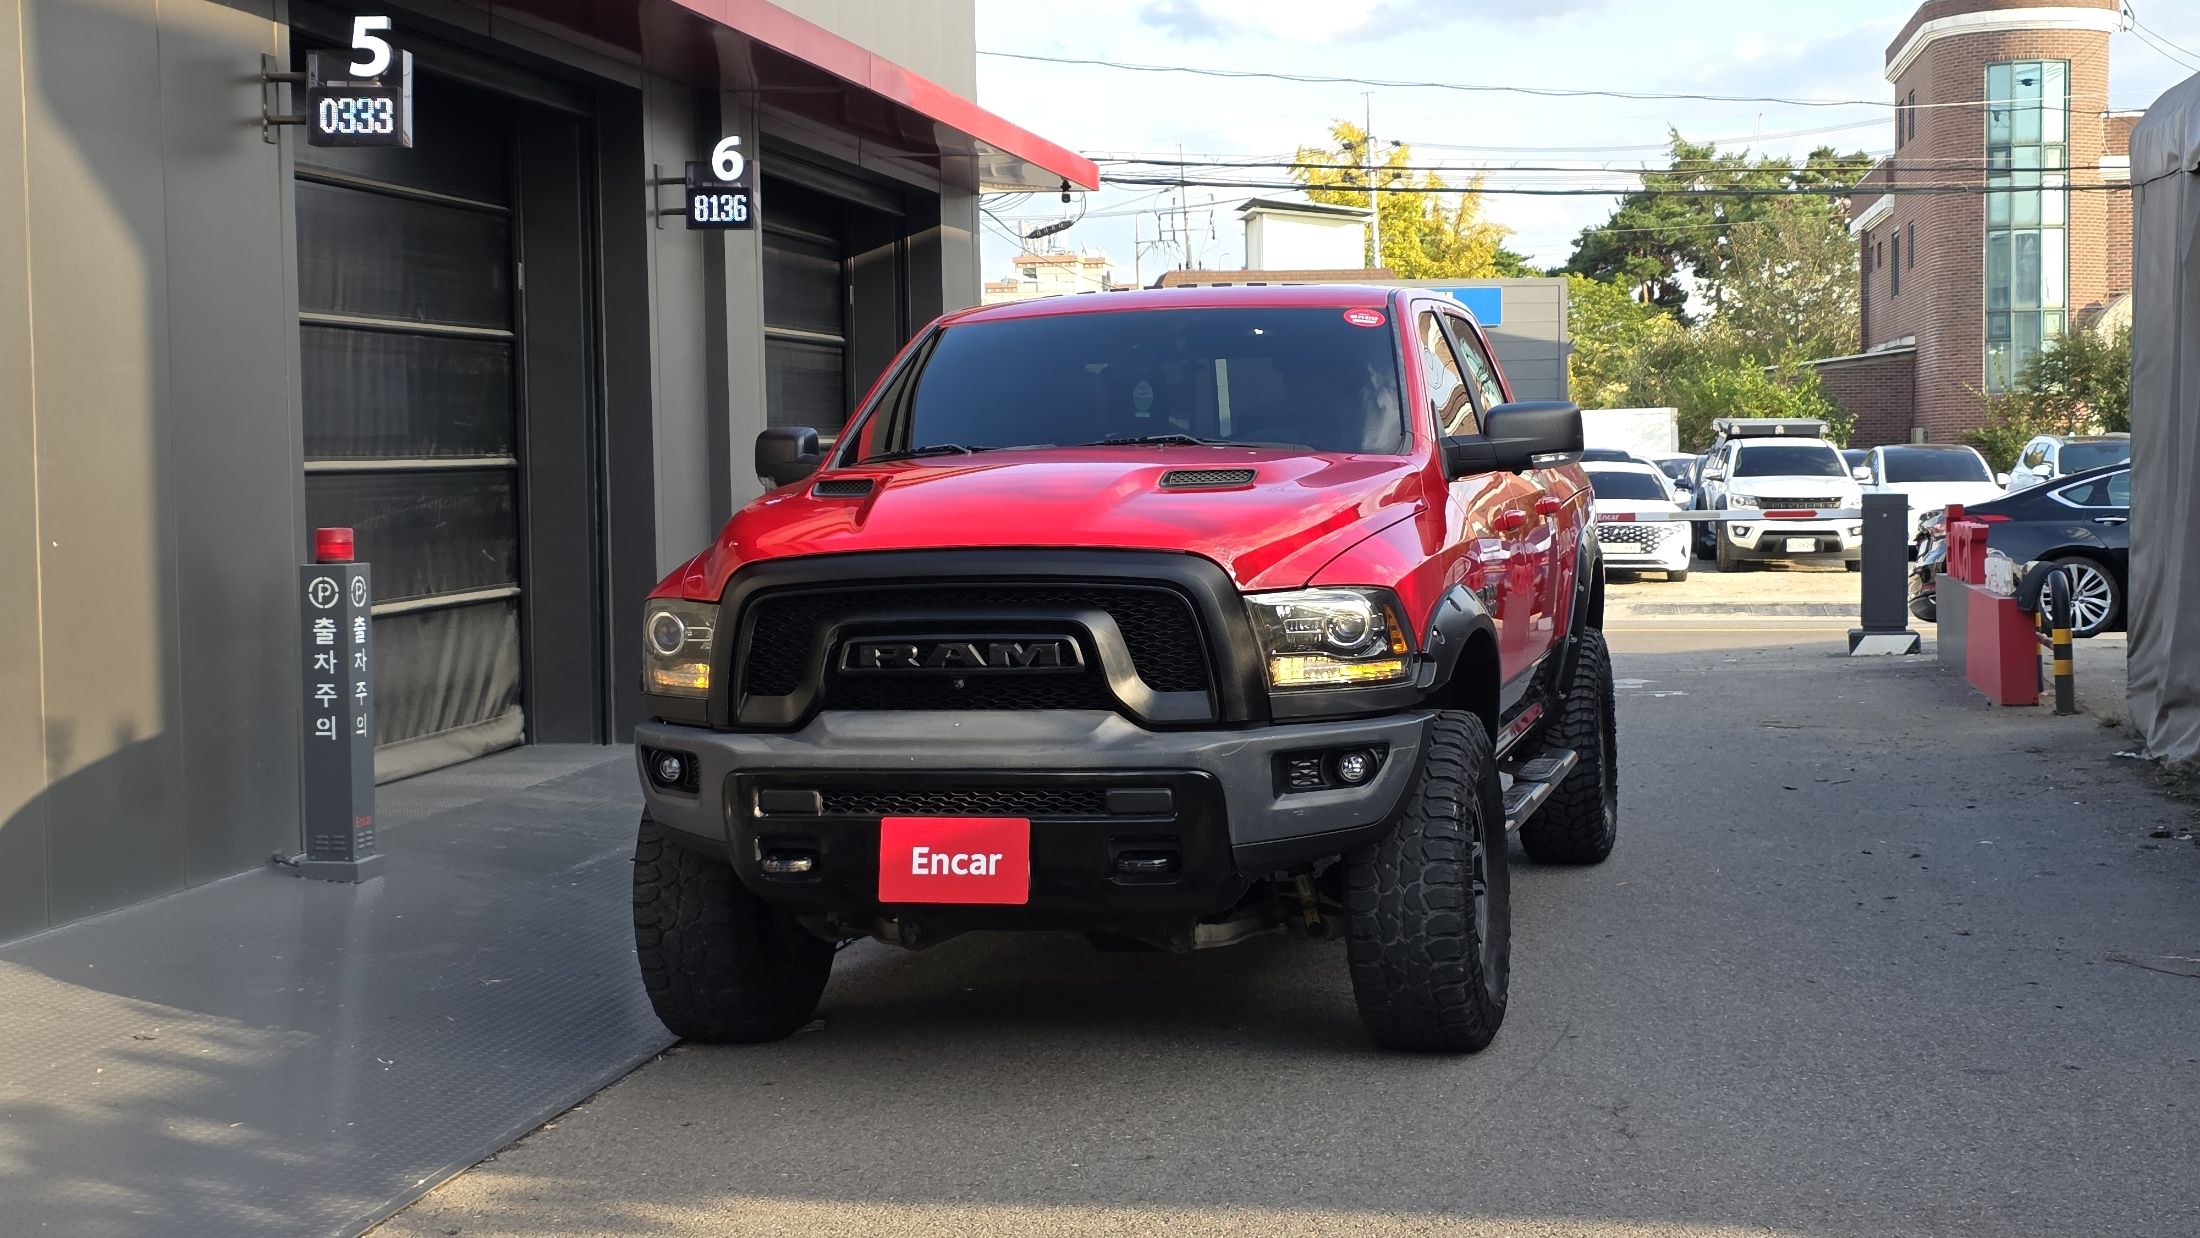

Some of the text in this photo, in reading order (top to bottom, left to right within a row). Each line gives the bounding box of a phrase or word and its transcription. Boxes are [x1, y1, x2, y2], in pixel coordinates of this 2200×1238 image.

[349, 15, 392, 77] 5
[320, 98, 394, 134] 0333
[711, 135, 744, 181] 6
[694, 194, 747, 222] 8136
[859, 643, 1061, 666] RAM
[312, 617, 338, 740] 출차주의
[911, 846, 1003, 876] Encar
